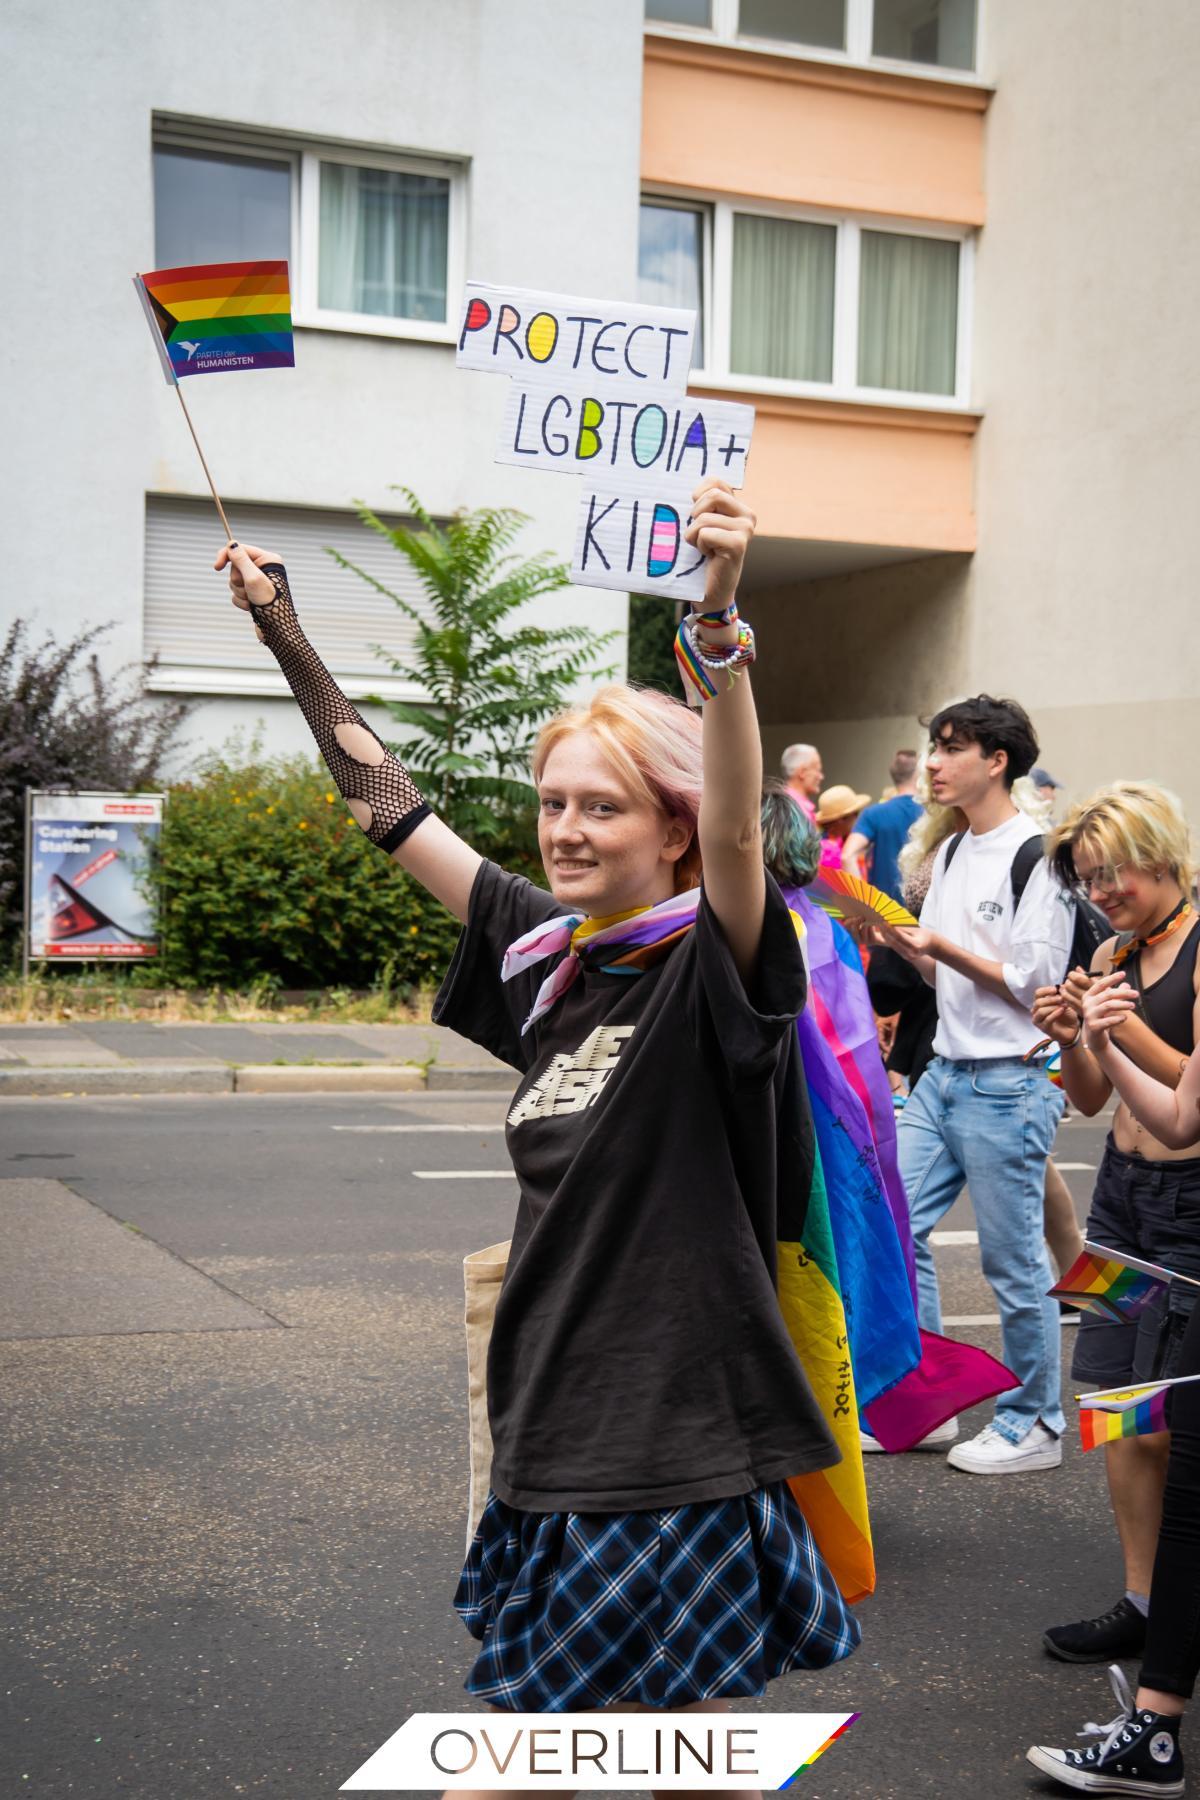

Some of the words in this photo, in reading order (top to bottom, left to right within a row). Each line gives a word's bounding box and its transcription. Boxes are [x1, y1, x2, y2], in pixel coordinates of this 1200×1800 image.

[459, 298, 689, 380] PROTECT
[197, 351, 223, 360] PARTEI
[197, 356, 253, 368] HUMANISTEN
[38, 825, 118, 842] Carsharing
[38, 840, 91, 854] Station
